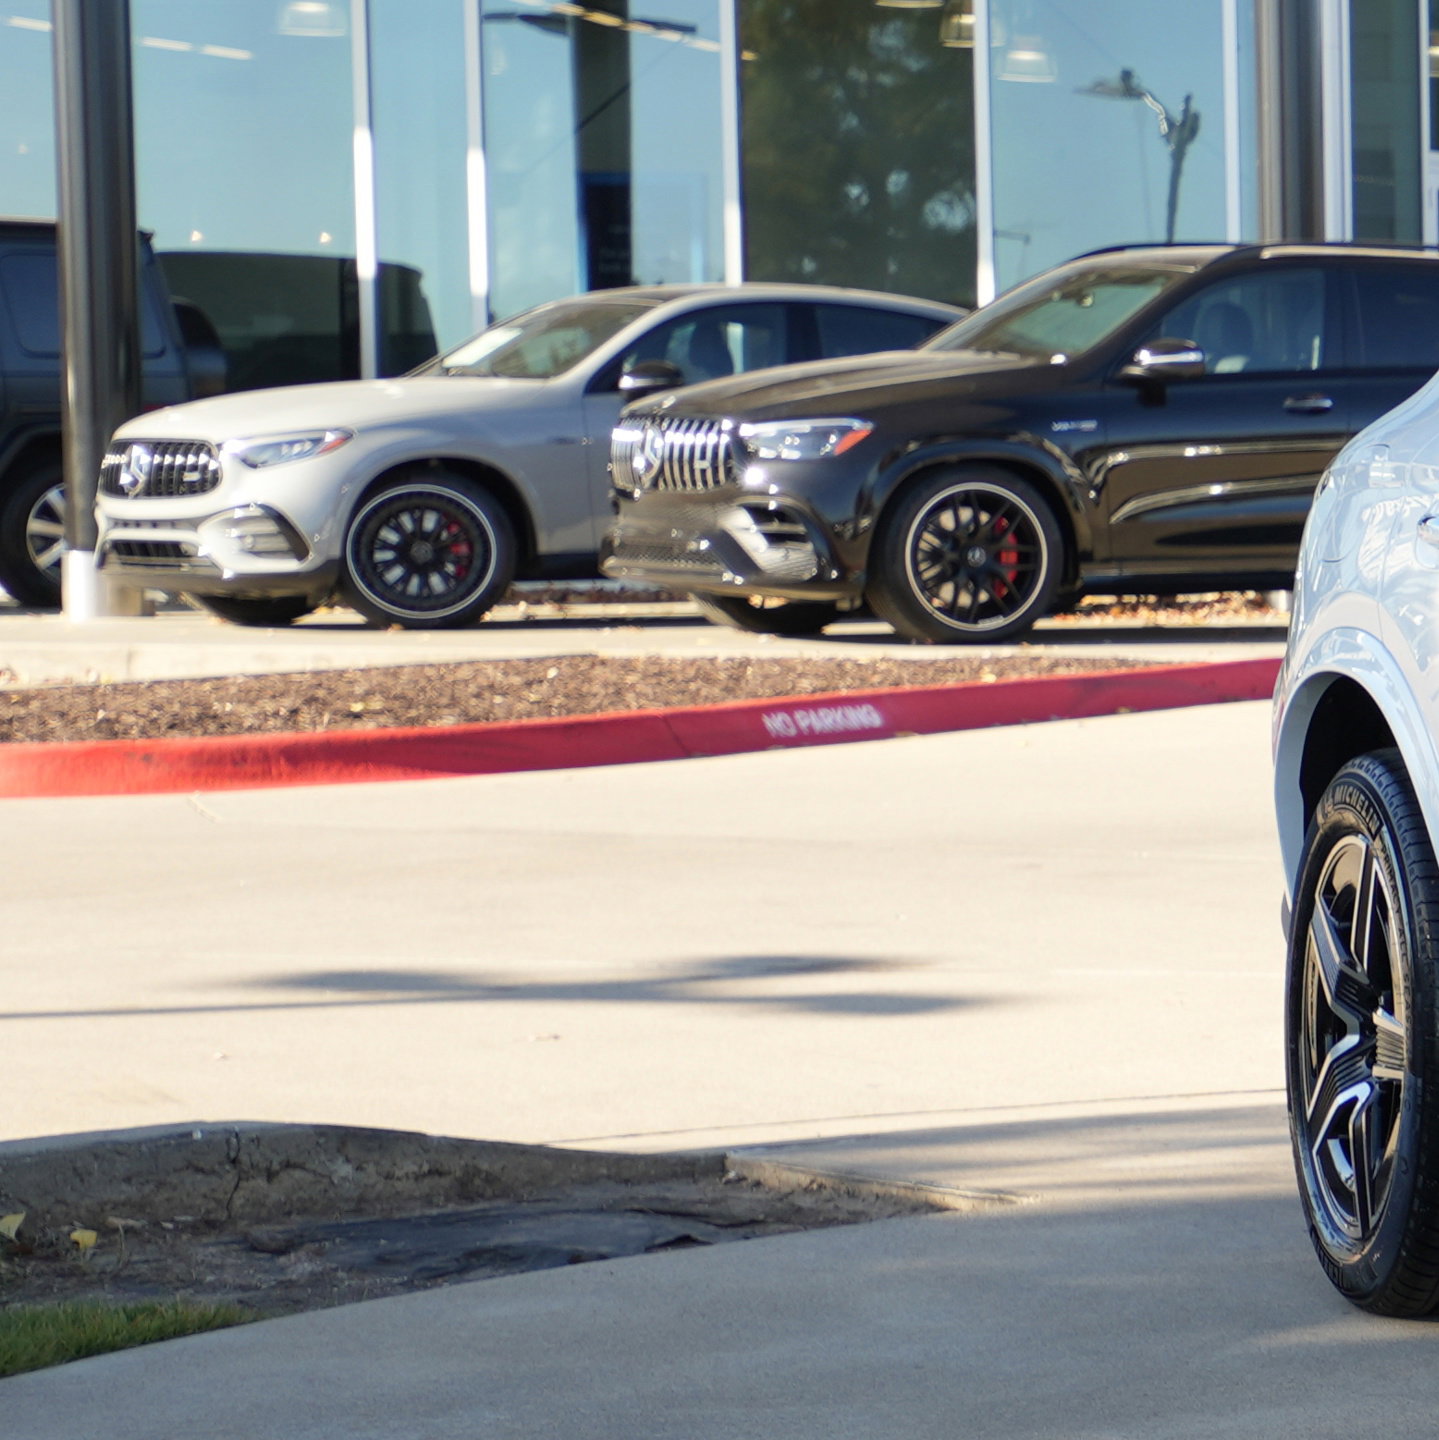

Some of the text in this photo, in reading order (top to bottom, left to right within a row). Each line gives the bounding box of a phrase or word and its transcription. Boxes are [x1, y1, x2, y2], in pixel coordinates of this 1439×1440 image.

[761, 705, 882, 738] NO PARKING
[1334, 784, 1380, 835] MICHELIN
